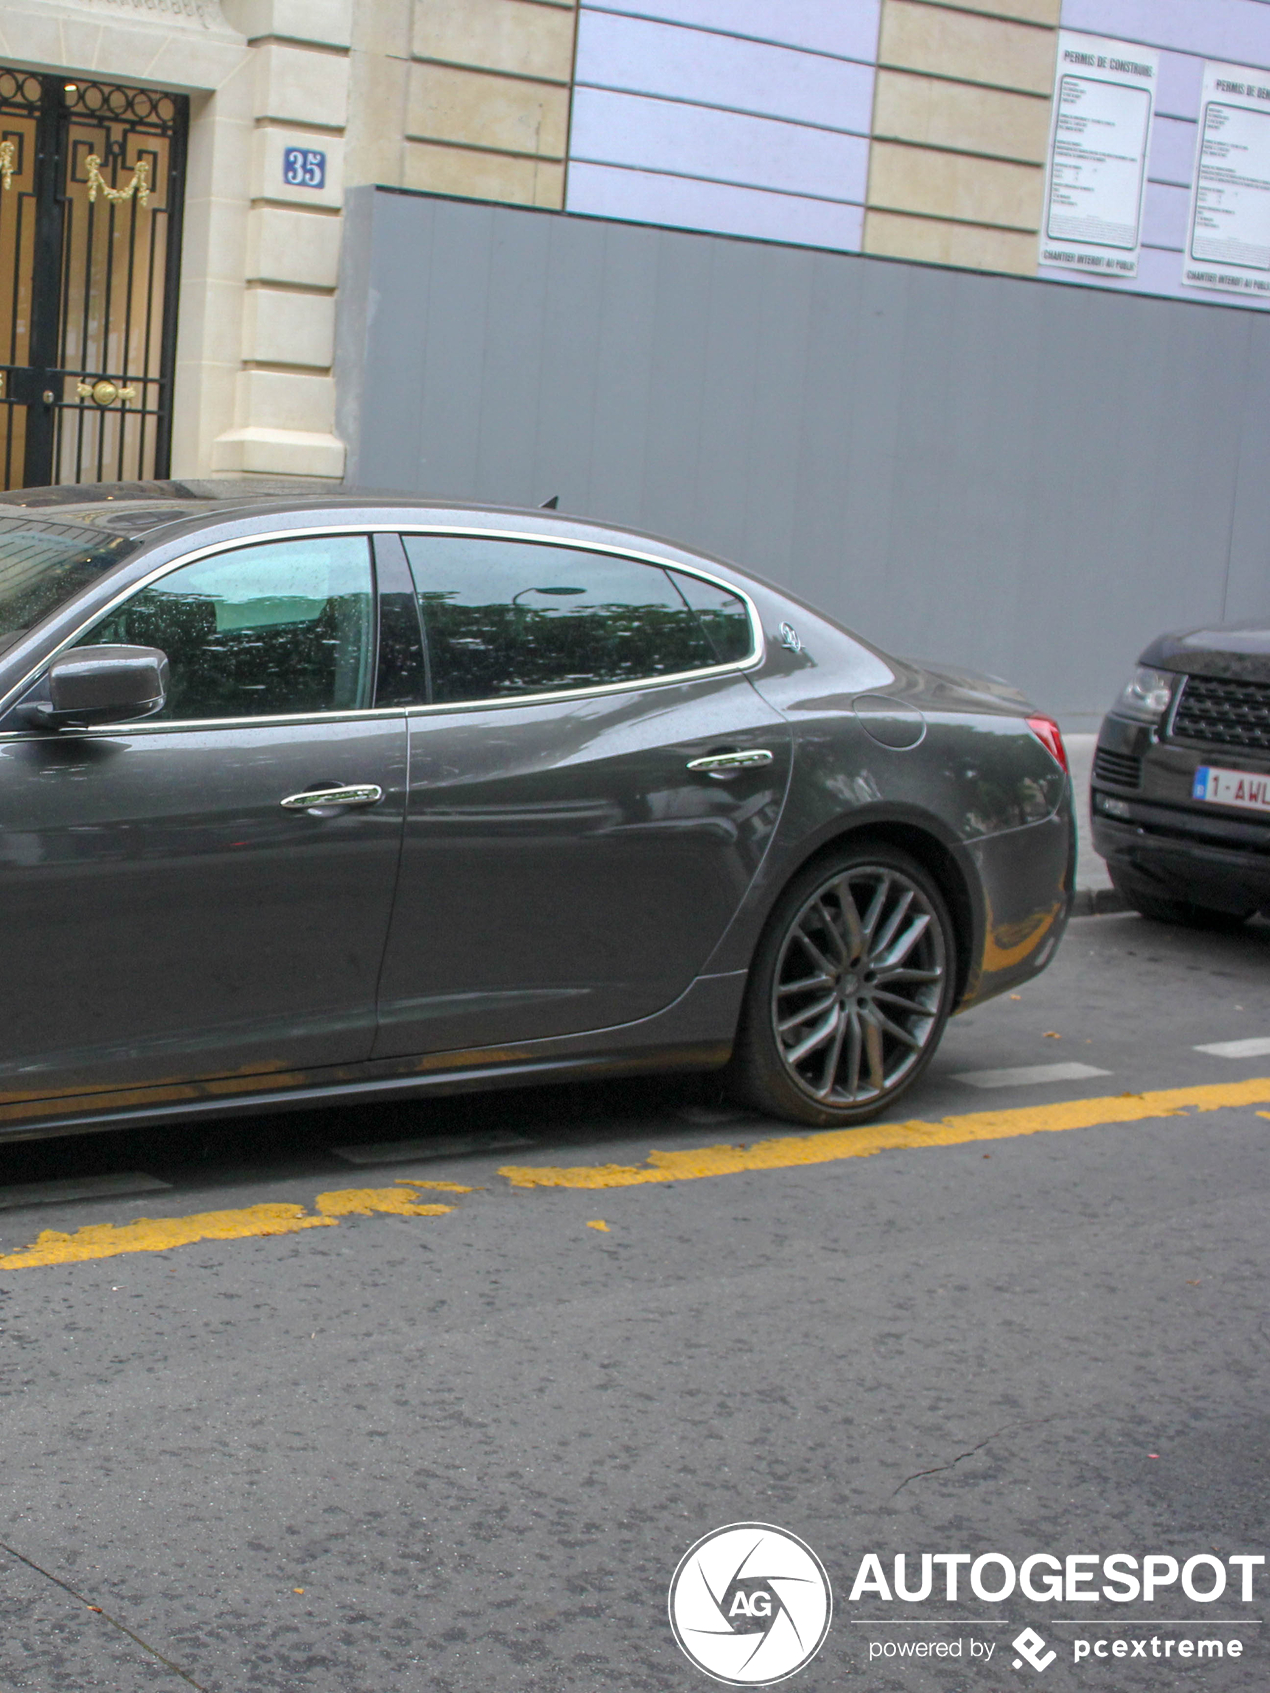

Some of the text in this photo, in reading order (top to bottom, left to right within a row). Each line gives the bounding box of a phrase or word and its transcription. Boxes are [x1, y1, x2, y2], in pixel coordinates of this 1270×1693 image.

[1064, 50, 1153, 78] PERMIS DE CONSTRUIRE
[1216, 79, 1245, 95] PERMIS
[1246, 84, 1256, 98] DE
[287, 151, 322, 187] 35
[1043, 249, 1076, 263] CHANTIER
